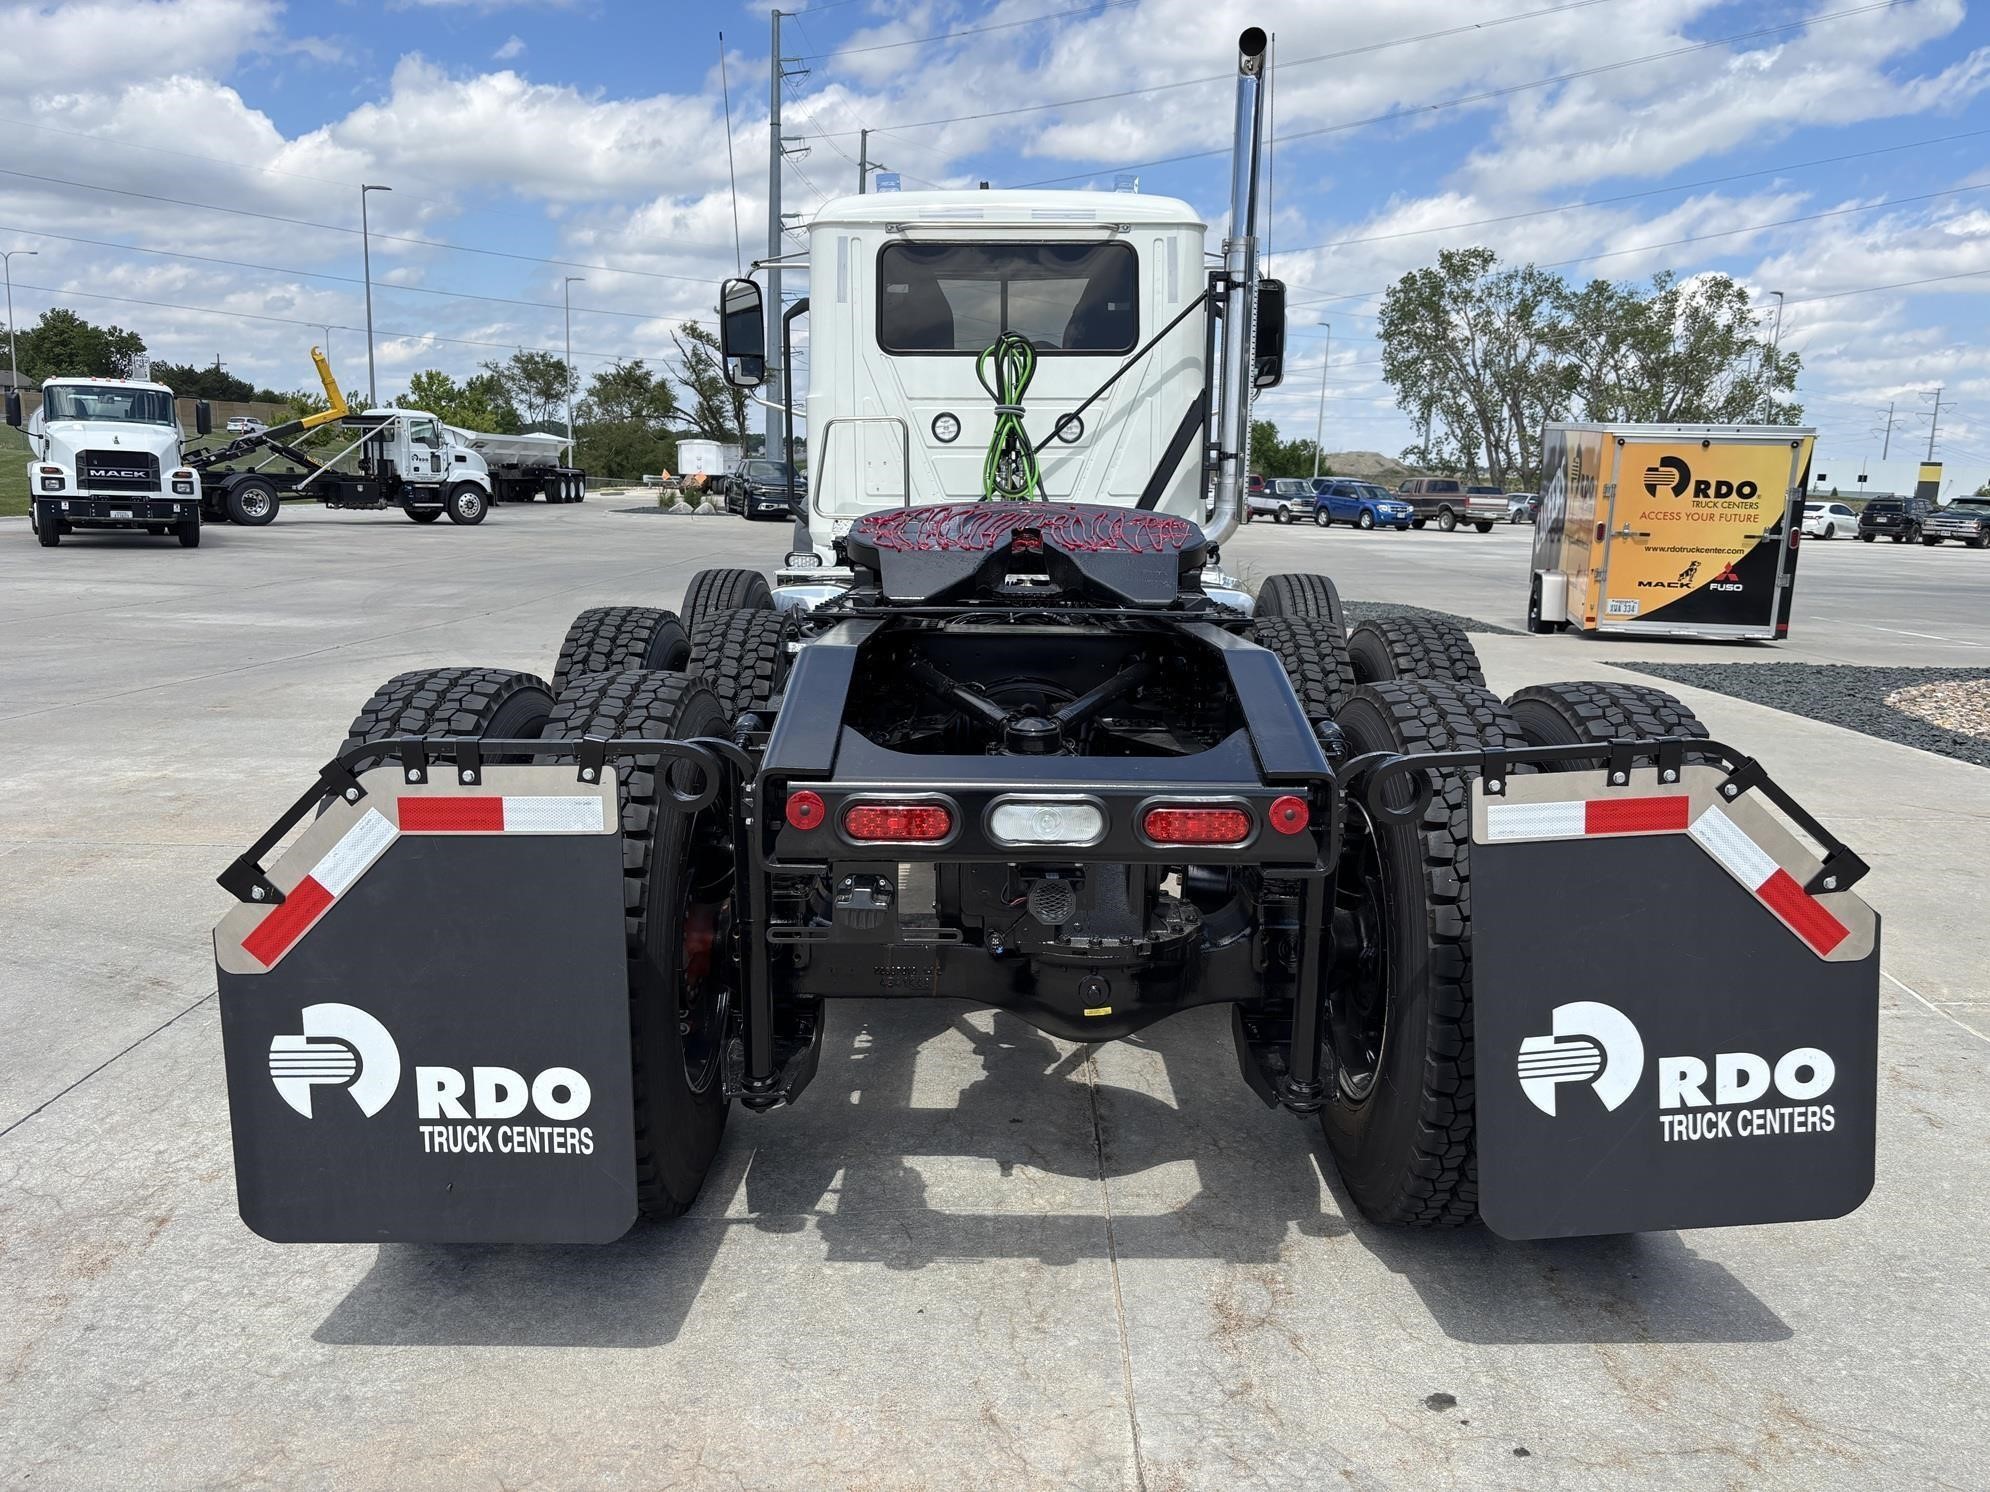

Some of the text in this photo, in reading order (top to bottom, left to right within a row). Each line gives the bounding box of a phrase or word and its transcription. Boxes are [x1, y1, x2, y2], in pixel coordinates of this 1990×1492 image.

[90, 469, 147, 478] MACK
[1692, 479, 1758, 500] RDO
[1691, 500, 1759, 510] TRUCK CENTERS
[1639, 511, 1760, 523] ACCESS YOUR FUTURE
[1644, 545, 1745, 555] www.rdotruckcenter.com
[1637, 580, 1692, 589] MACK
[1709, 583, 1743, 591] FUSO
[1658, 1047, 1836, 1109] RDO
[415, 1066, 592, 1121] RDO
[1659, 1105, 1836, 1142] TRUCK CENTERS
[419, 1125, 594, 1155] TRUCK CENTERS
